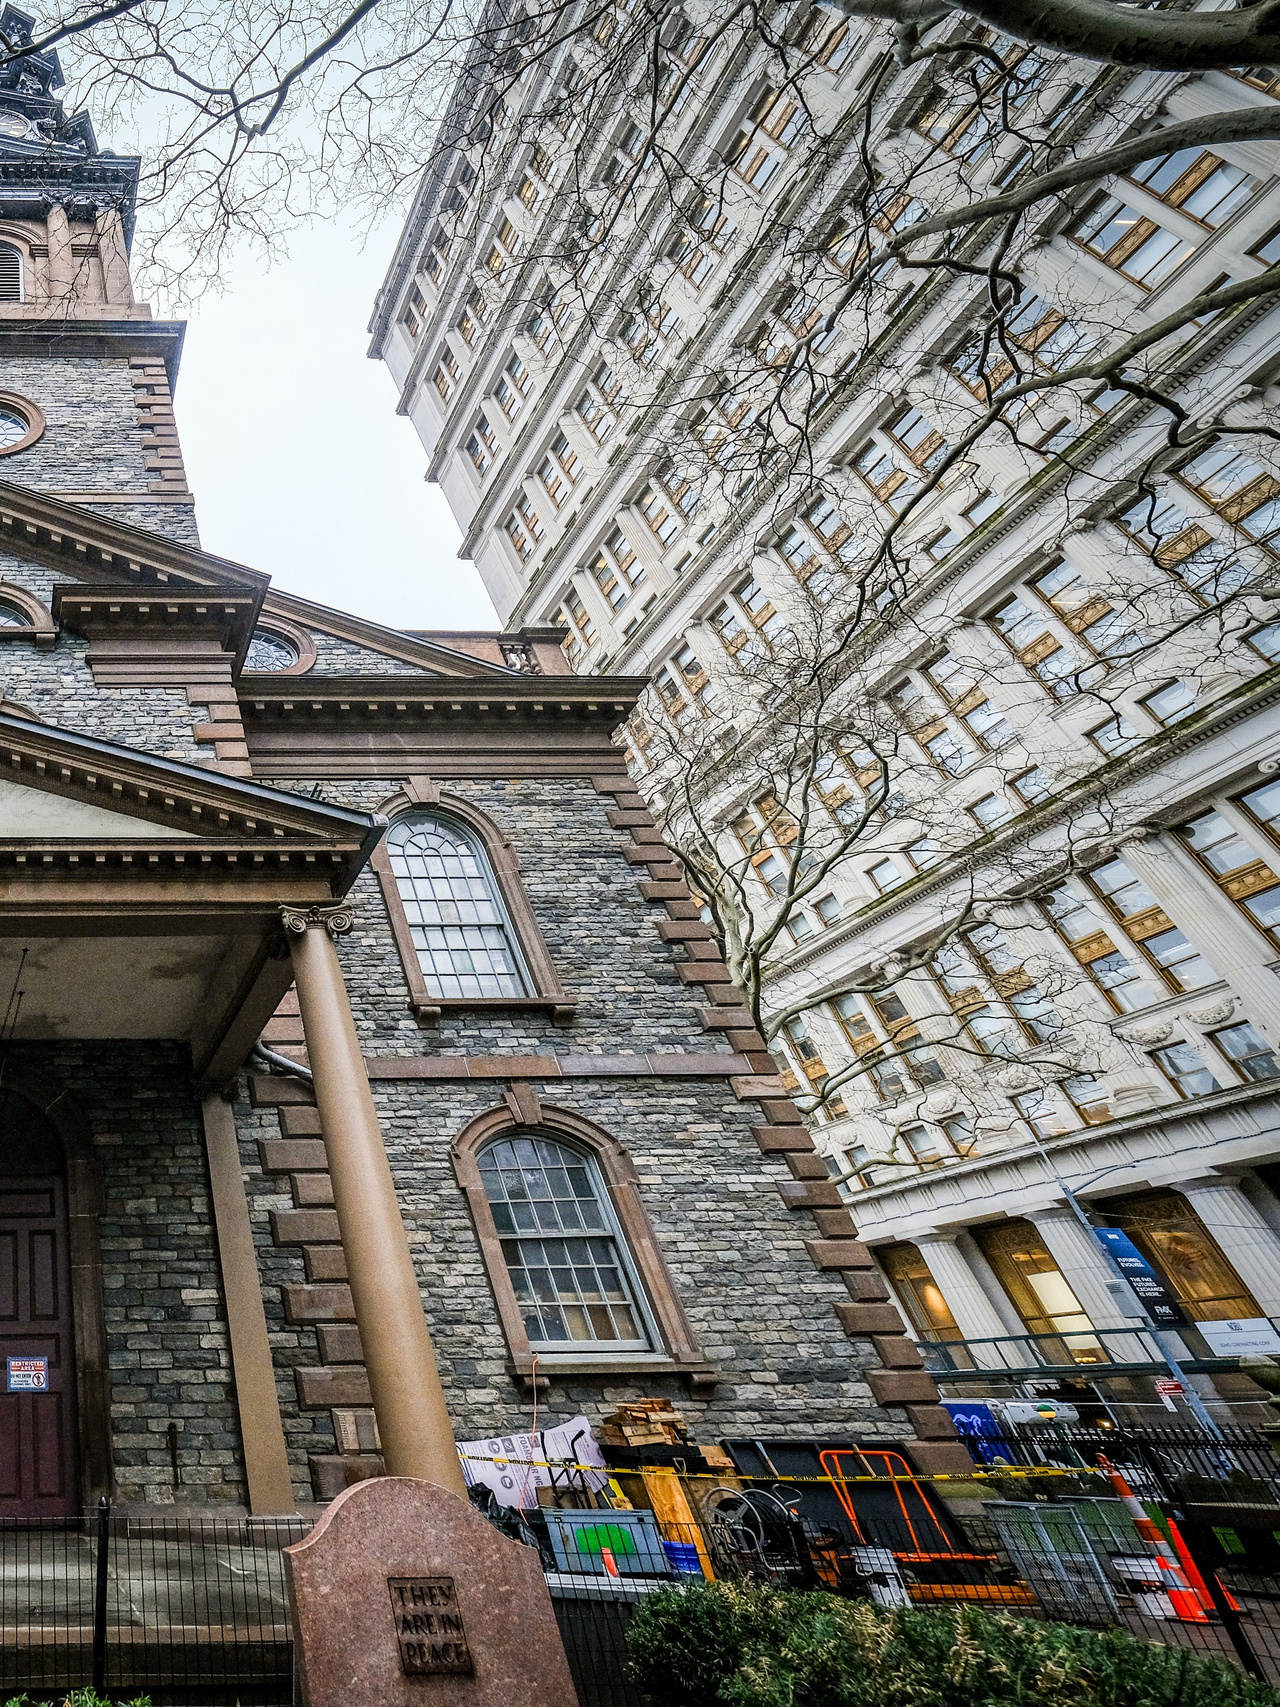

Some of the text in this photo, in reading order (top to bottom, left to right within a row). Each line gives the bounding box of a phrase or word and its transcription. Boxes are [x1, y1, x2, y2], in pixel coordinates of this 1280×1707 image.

[393, 1585, 453, 1607] THEY
[400, 1613, 461, 1636] ARE IN
[404, 1642, 467, 1664] PEACE
